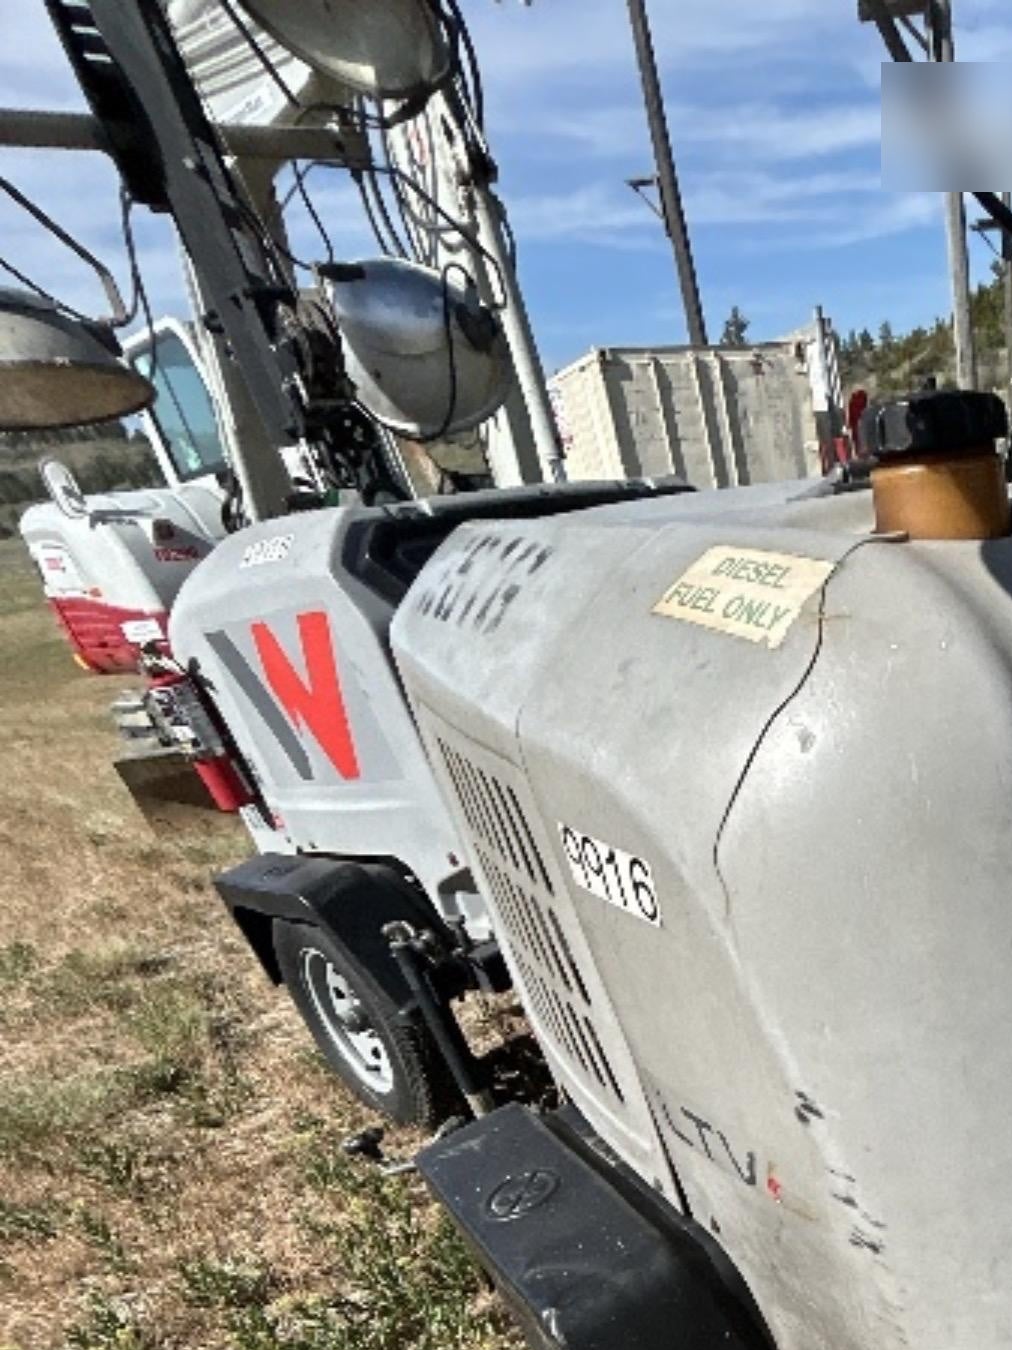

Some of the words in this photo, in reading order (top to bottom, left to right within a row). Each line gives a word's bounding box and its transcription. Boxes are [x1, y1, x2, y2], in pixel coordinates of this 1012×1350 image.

[712, 557, 791, 588] DIESEL
[665, 581, 720, 612] FUEL
[722, 593, 790, 630] ONLY
[563, 826, 658, 922] 9916
